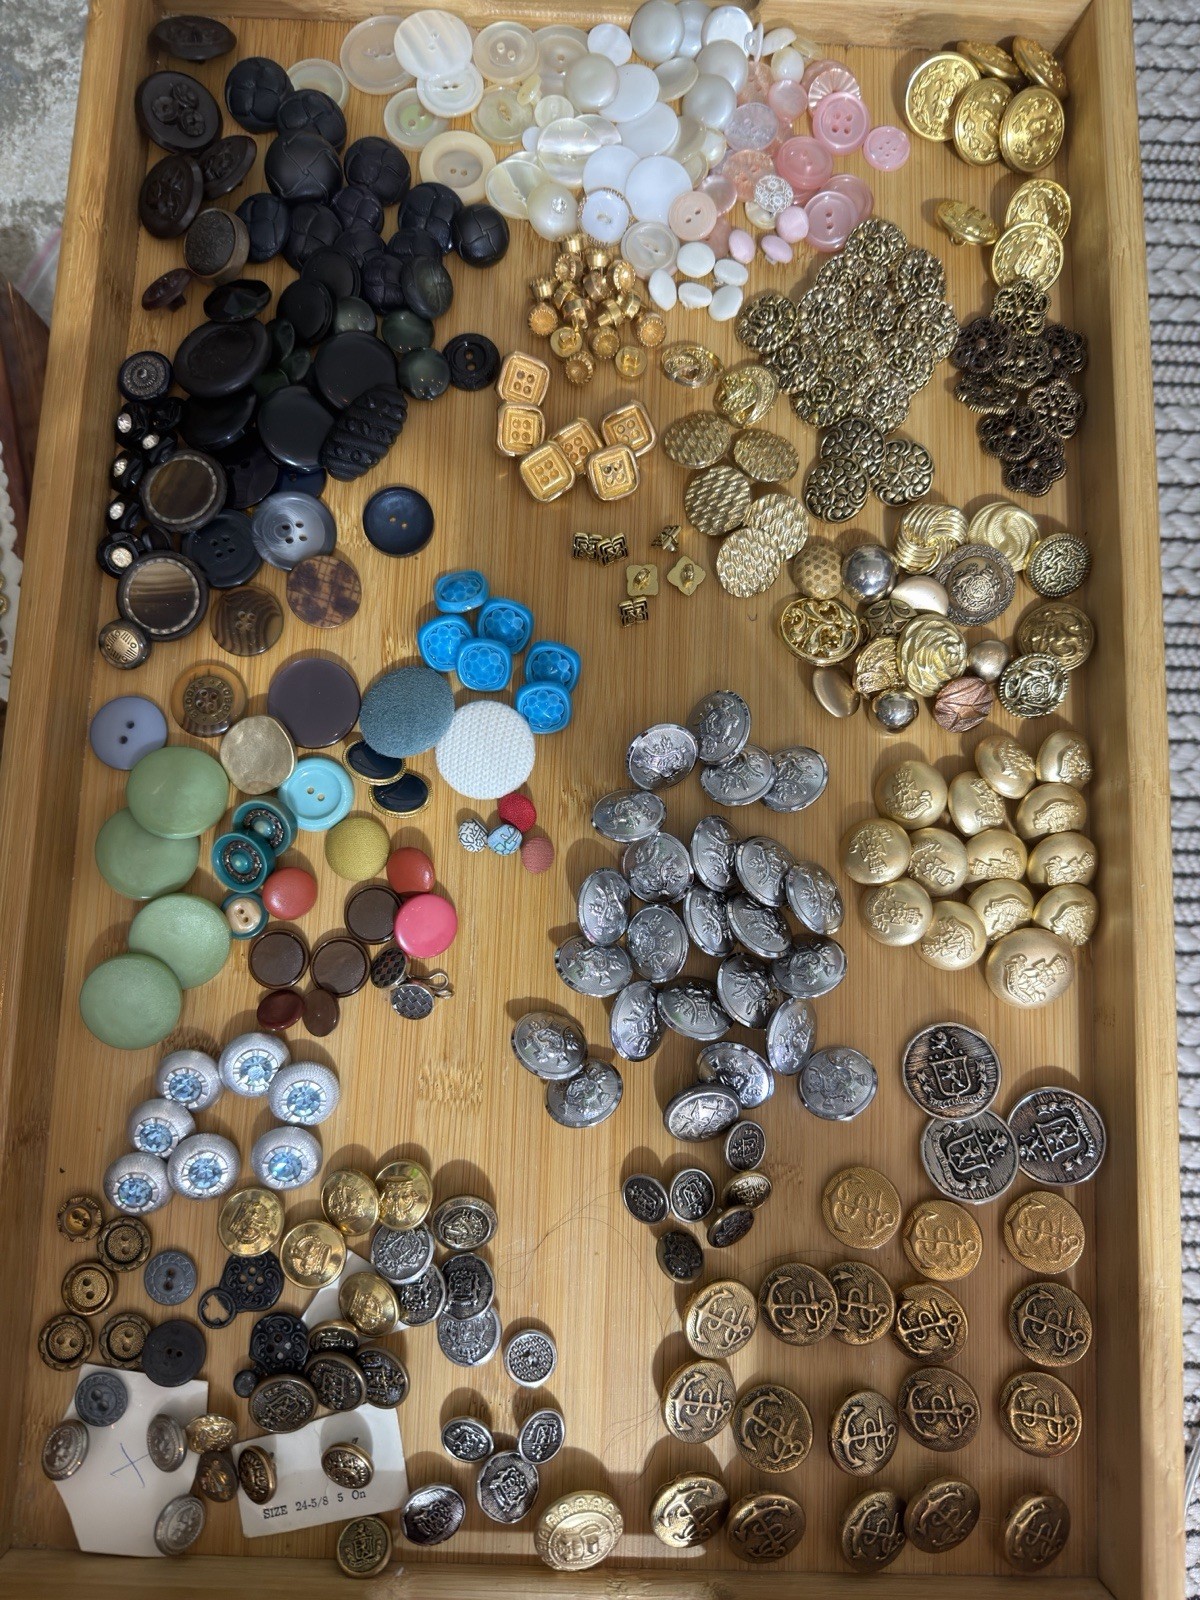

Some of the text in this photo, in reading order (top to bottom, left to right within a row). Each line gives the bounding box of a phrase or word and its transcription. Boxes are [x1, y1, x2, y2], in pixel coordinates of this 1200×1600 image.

[263, 1489, 367, 1519] SIZE 24-5/8 5 On
